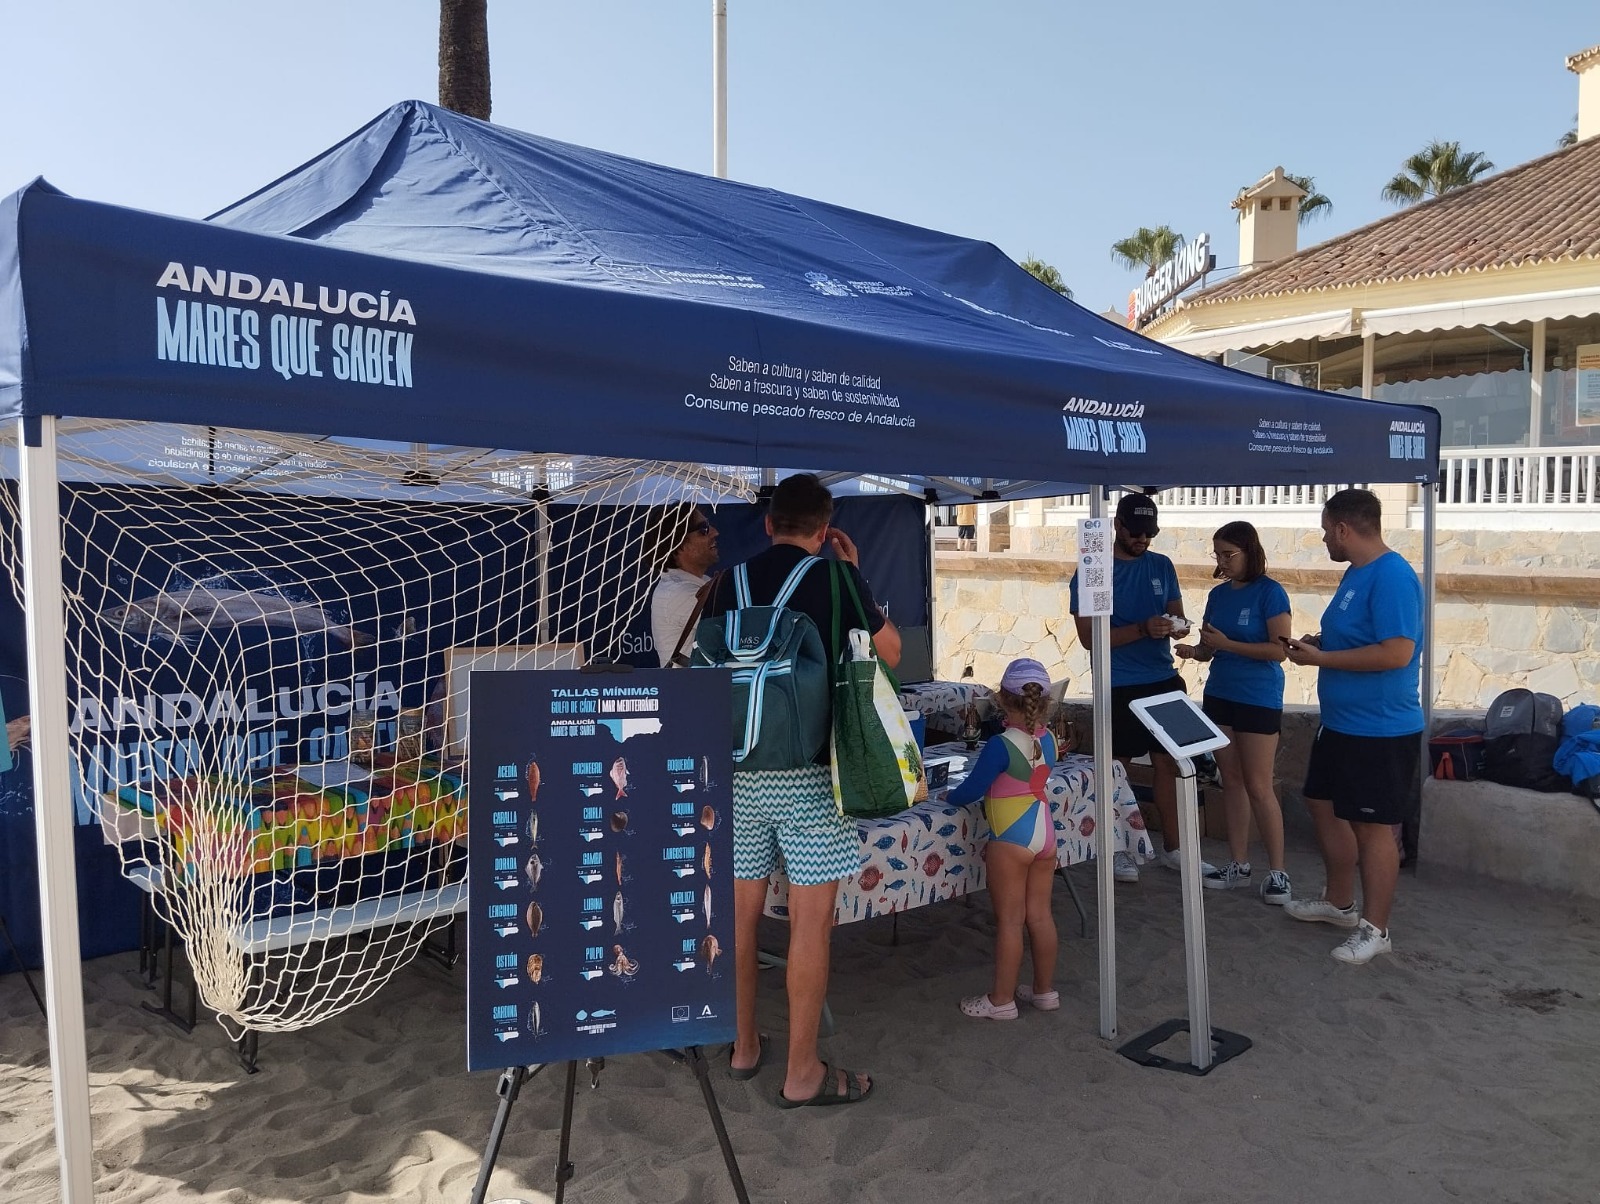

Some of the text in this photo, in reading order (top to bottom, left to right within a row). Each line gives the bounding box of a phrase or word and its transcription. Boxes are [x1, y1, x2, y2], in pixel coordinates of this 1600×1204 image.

[1135, 260, 1172, 318] BURGER
[1174, 232, 1207, 289] KING
[156, 261, 417, 326] ANDALUCÍA
[156, 296, 414, 388] MARES QUE SABEN
[728, 356, 881, 390] Saben a cultura y saben de calidad
[709, 373, 741, 391] Saben
[744, 382, 751, 392] a
[753, 378, 792, 397] frescura
[794, 387, 800, 400] y
[802, 385, 829, 401] saben
[831, 388, 843, 402] de
[684, 393, 916, 428] Consume pescado fresco de Andalucía
[1062, 396, 1145, 419] ANDALUCÍA
[1389, 420, 1426, 434] ANDALUCÍA
[740, 636, 760, 645] M&S
[551, 686, 659, 697] TALLAS MÍNIMAS
[71, 674, 402, 733] ANDALUCÍA
[551, 698, 597, 714] GOLFO DE CÁDIZ
[602, 696, 659, 713] MAR MEDITERRÁNEO
[551, 718, 595, 726] ANDALUCÍA
[496, 951, 518, 968] OSTIÓN
